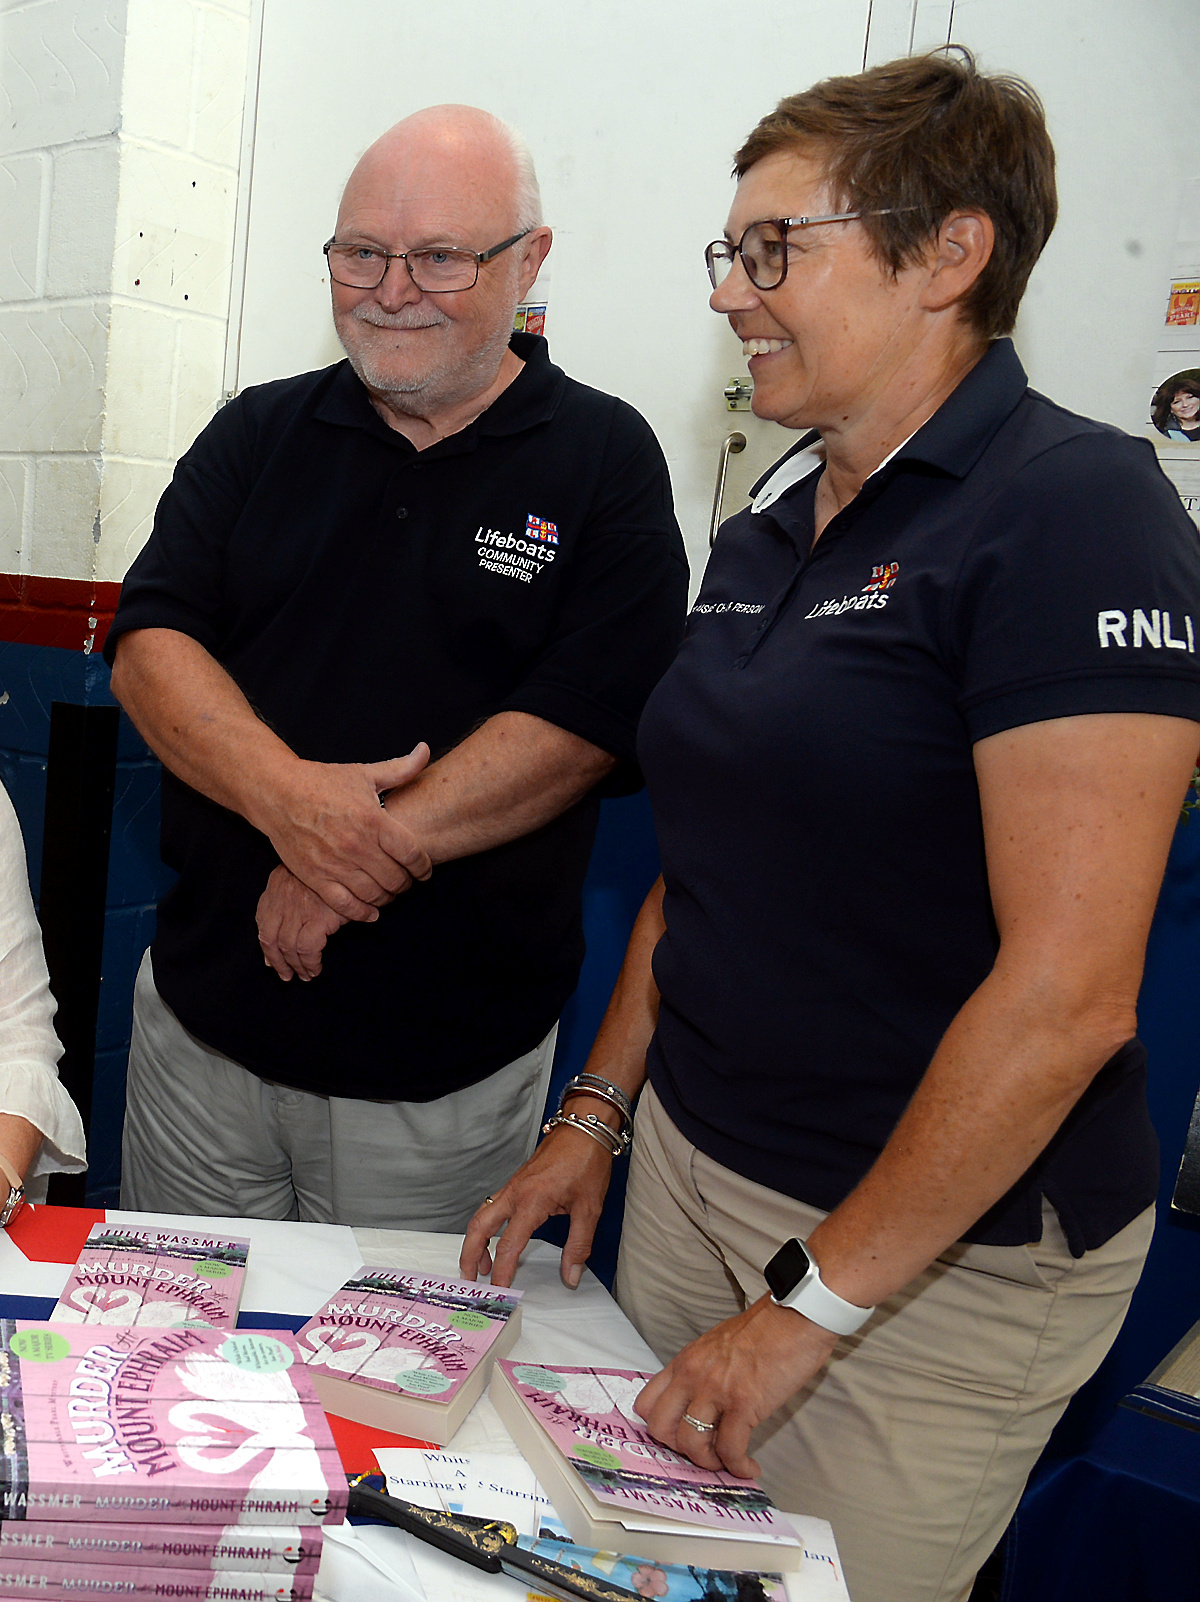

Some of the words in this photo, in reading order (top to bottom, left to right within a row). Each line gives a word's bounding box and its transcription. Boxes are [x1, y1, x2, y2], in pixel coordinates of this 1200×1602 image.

[474, 526, 556, 562] Lifeboats
[477, 546, 544, 574] COMMUNITY
[478, 558, 533, 583] PRESENTER
[804, 590, 890, 620] Lifeboats
[1097, 608, 1195, 653] RNLI
[100, 1229, 152, 1242] JULIE
[156, 1233, 237, 1250] WASSMER
[78, 1262, 213, 1295] MURDER
[364, 1271, 418, 1287] JULIE
[421, 1279, 507, 1302] WASSMER
[75, 1274, 154, 1288] MOUNT
[155, 1281, 230, 1320] EPHRAIM
[327, 1303, 463, 1345] MURDER
[319, 1314, 401, 1334] MOUNT
[398, 1328, 468, 1372] EPHRAIM
[117, 1330, 206, 1391] EPHRAIM
[67, 1344, 137, 1478] MURDER
[525, 1392, 630, 1439] EPHRAIM
[115, 1394, 178, 1477] MOUNT
[389, 1476, 455, 1491] Starring
[455, 1469, 466, 1478] A
[3, 1491, 82, 1509] WASSMER
[94, 1495, 171, 1511] MURDER
[189, 1498, 237, 1512] MOUNT
[239, 1499, 299, 1513] EPHRAIM
[603, 1483, 708, 1516] WASSMER
[715, 1505, 774, 1525] JULIE
[66, 1537, 143, 1554] MURDER
[162, 1541, 210, 1556] MOUNT
[212, 1544, 272, 1560] EPHRAIM
[61, 1577, 136, 1594] MURDER
[154, 1584, 202, 1599] MOUNT
[204, 1587, 264, 1602] EPHRAIM
